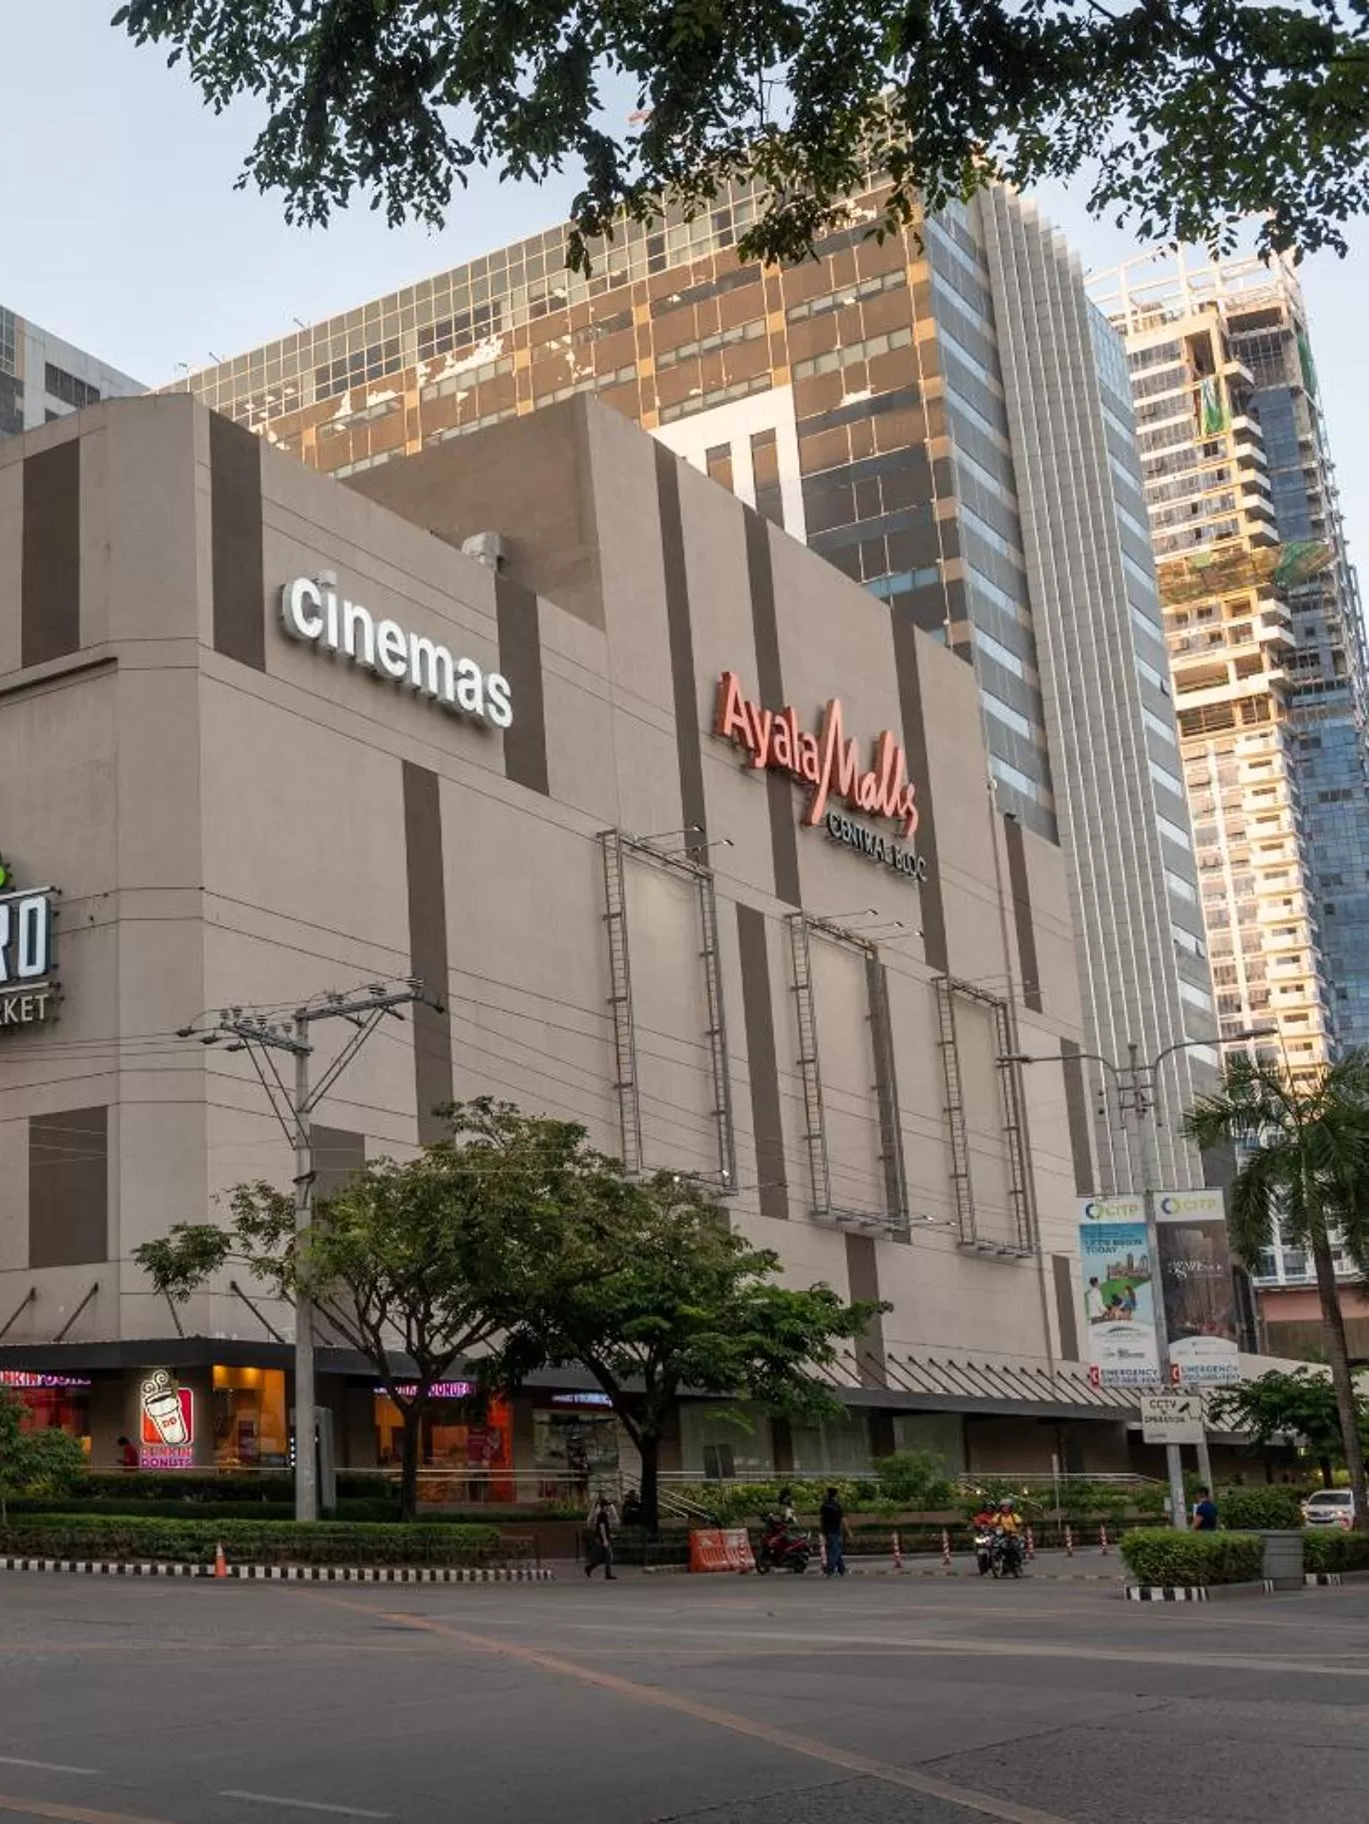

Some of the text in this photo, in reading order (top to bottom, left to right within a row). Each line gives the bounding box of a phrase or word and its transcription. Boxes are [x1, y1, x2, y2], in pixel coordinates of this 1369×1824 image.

[282, 570, 514, 729] cinemas
[716, 671, 919, 838] Ayala Malls
[827, 811, 894, 867] CENTRAL
[1149, 1400, 1176, 1409] CCTV
